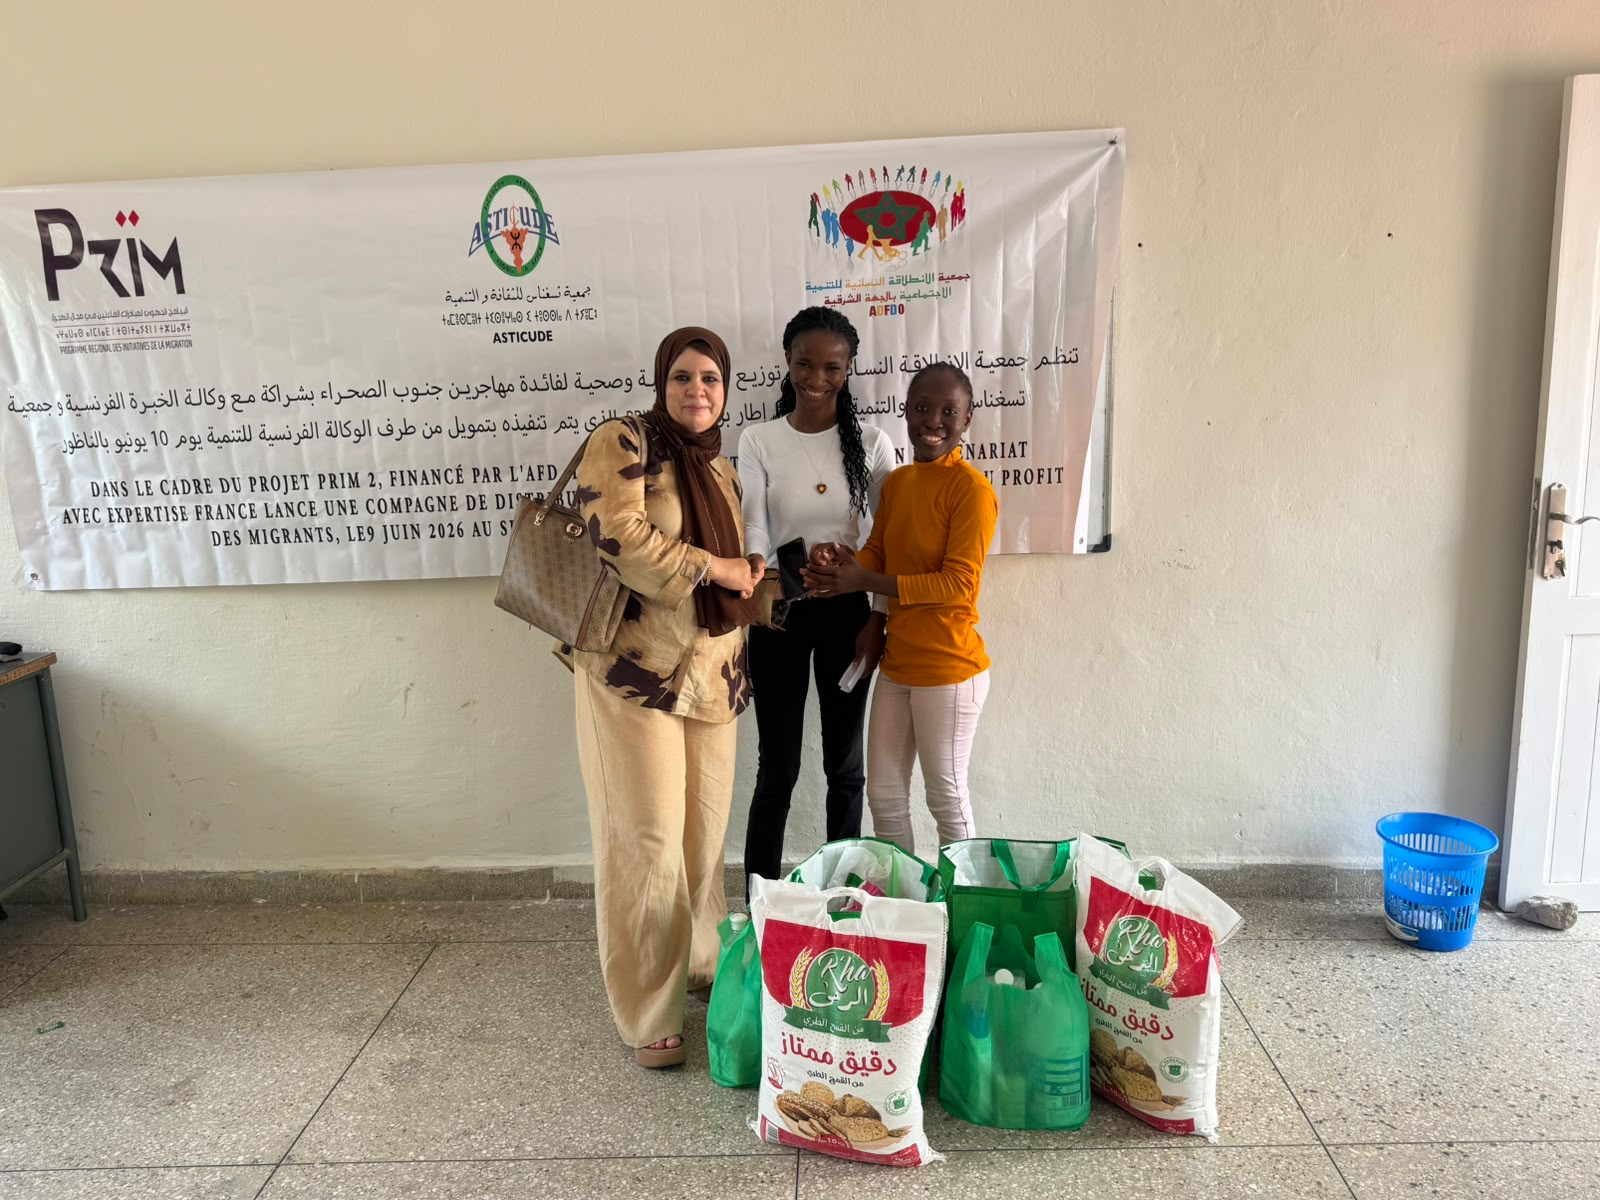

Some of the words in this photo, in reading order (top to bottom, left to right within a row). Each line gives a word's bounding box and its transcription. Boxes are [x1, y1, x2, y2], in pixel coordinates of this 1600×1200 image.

[806, 279, 842, 293] للتنمية
[889, 273, 935, 286] الانطلاقة
[938, 272, 971, 284] جمعية
[445, 288, 480, 307] التنمية
[564, 286, 591, 302] جمعية
[824, 294, 861, 308] الشرقية
[900, 287, 951, 302] الاجتماعية
[493, 330, 553, 344] ASTICUDE
[975, 350, 1028, 374] جمعية
[1034, 346, 1080, 371] تنظم
[448, 376, 515, 400] مهاجرين
[520, 372, 568, 392] لفائدة
[574, 372, 633, 396] وصحية
[736, 365, 782, 392] توزيع
[66, 392, 126, 417] الفرنسية
[130, 390, 179, 414] الخبرة
[184, 388, 226, 410] وكالة
[230, 394, 256, 413] مع
[261, 384, 315, 408] بشراكة
[320, 380, 387, 405] الصحراء
[393, 382, 443, 403] جنوب
[206, 424, 253, 450] للتنمية
[258, 421, 320, 448] الفرنسية
[324, 419, 372, 444] الوكالة
[377, 417, 417, 442] طرف
[422, 422, 443, 440] من
[448, 416, 497, 440] بتمويل
[502, 414, 548, 437] تنفيذه
[554, 416, 579, 435] يتم
[62, 430, 110, 455] بالناظور
[114, 432, 148, 454] يونيو
[150, 430, 169, 447] 10
[175, 432, 202, 452] يوم
[90, 480, 129, 498] DANS
[135, 480, 154, 497] LE
[160, 478, 214, 496] CADRE
[219, 476, 242, 494] DU
[248, 474, 310, 496] PROJET
[318, 472, 361, 490] PRIM
[368, 472, 383, 490] 2,
[389, 464, 465, 487] FINANCÉ
[472, 466, 502, 484] PAR
[510, 464, 558, 482] L'AFD
[63, 507, 102, 524] AVEC
[107, 505, 189, 524] EXPERTISE
[195, 502, 258, 521] FRANCE
[264, 500, 318, 519] LANCE
[324, 499, 359, 517] UNE
[365, 495, 459, 515] COMPAGNE
[466, 494, 489, 512] DE
[1002, 467, 1064, 486] PROFIT
[211, 530, 242, 547] DES
[248, 526, 341, 545] MIGRANTS,
[346, 525, 375, 542] LE9
[382, 524, 421, 544] JUIN
[428, 522, 464, 539] 2026
[472, 520, 492, 538] AU
[830, 1022, 850, 1033] القمح
[853, 1026, 864, 1035] من
[1122, 1008, 1174, 1040] دقيق
[781, 1032, 834, 1065] ممتاز
[839, 1050, 898, 1077] دقيق
